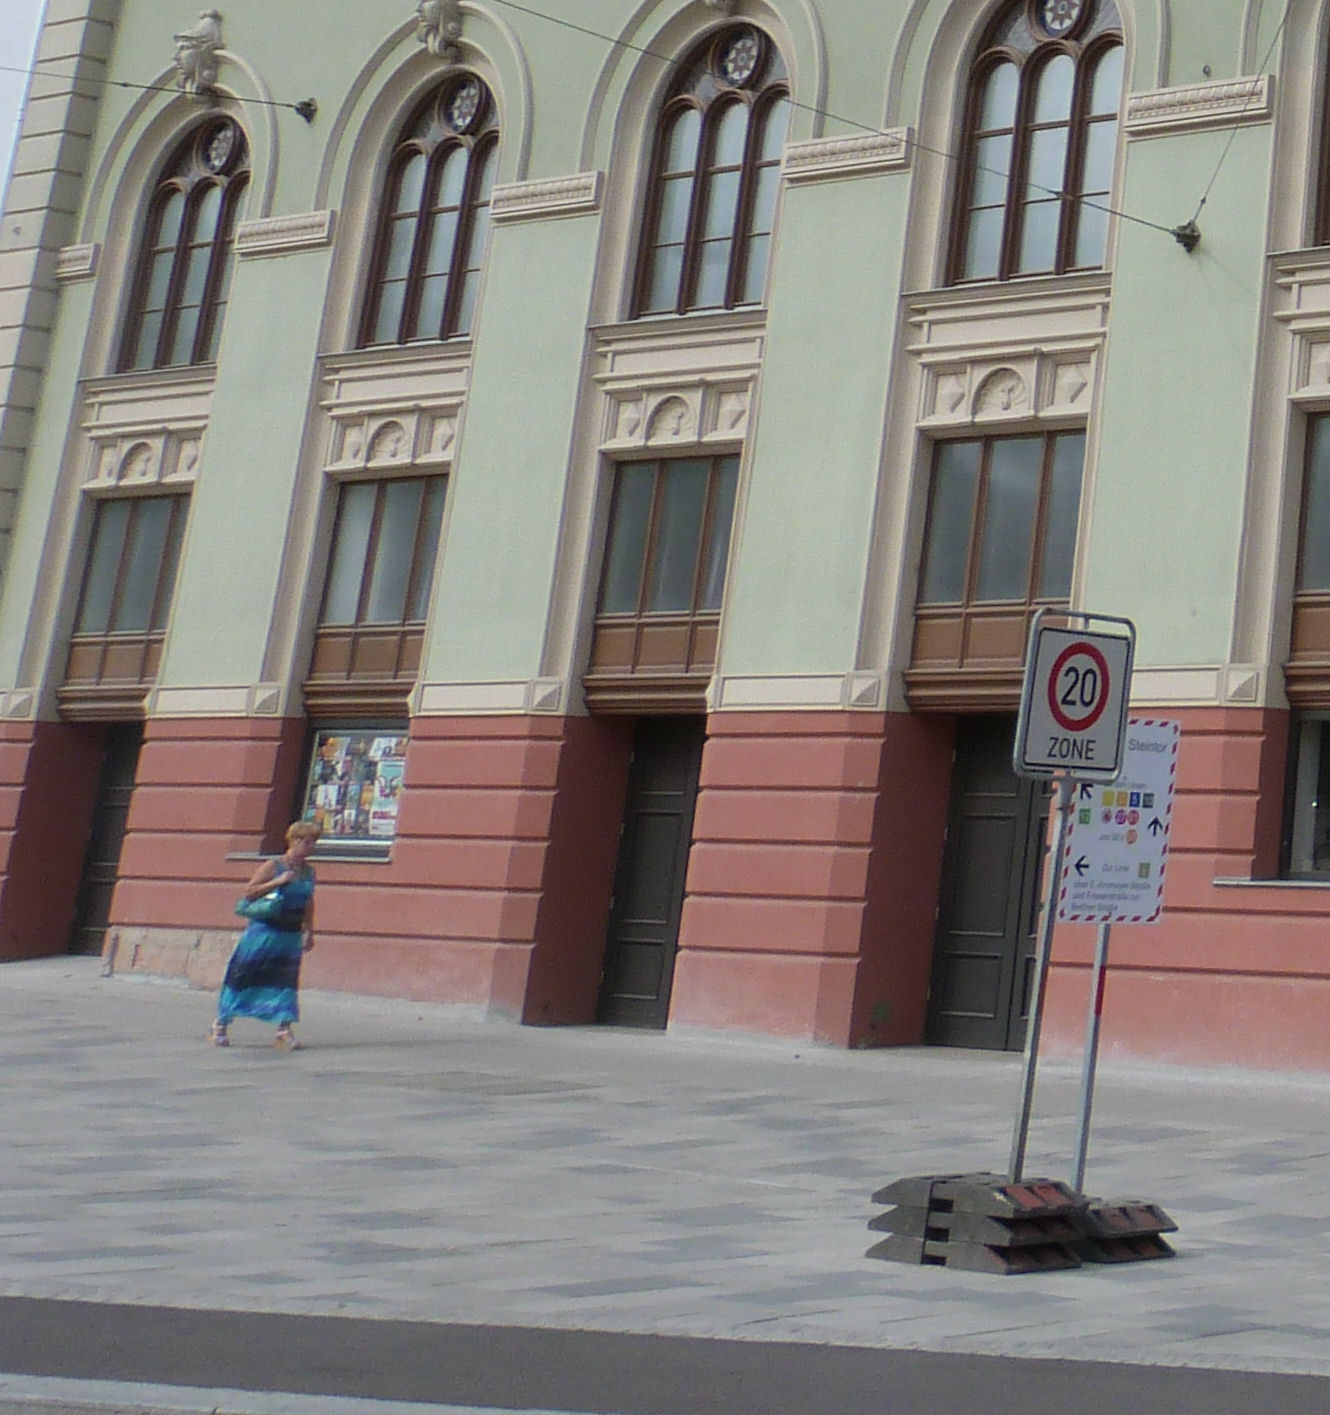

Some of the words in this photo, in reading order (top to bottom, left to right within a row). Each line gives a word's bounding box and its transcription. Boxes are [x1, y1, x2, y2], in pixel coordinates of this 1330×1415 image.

[1060, 665, 1098, 708] 20
[1047, 736, 1097, 761] ZONE
[1128, 739, 1168, 754] Steintor
